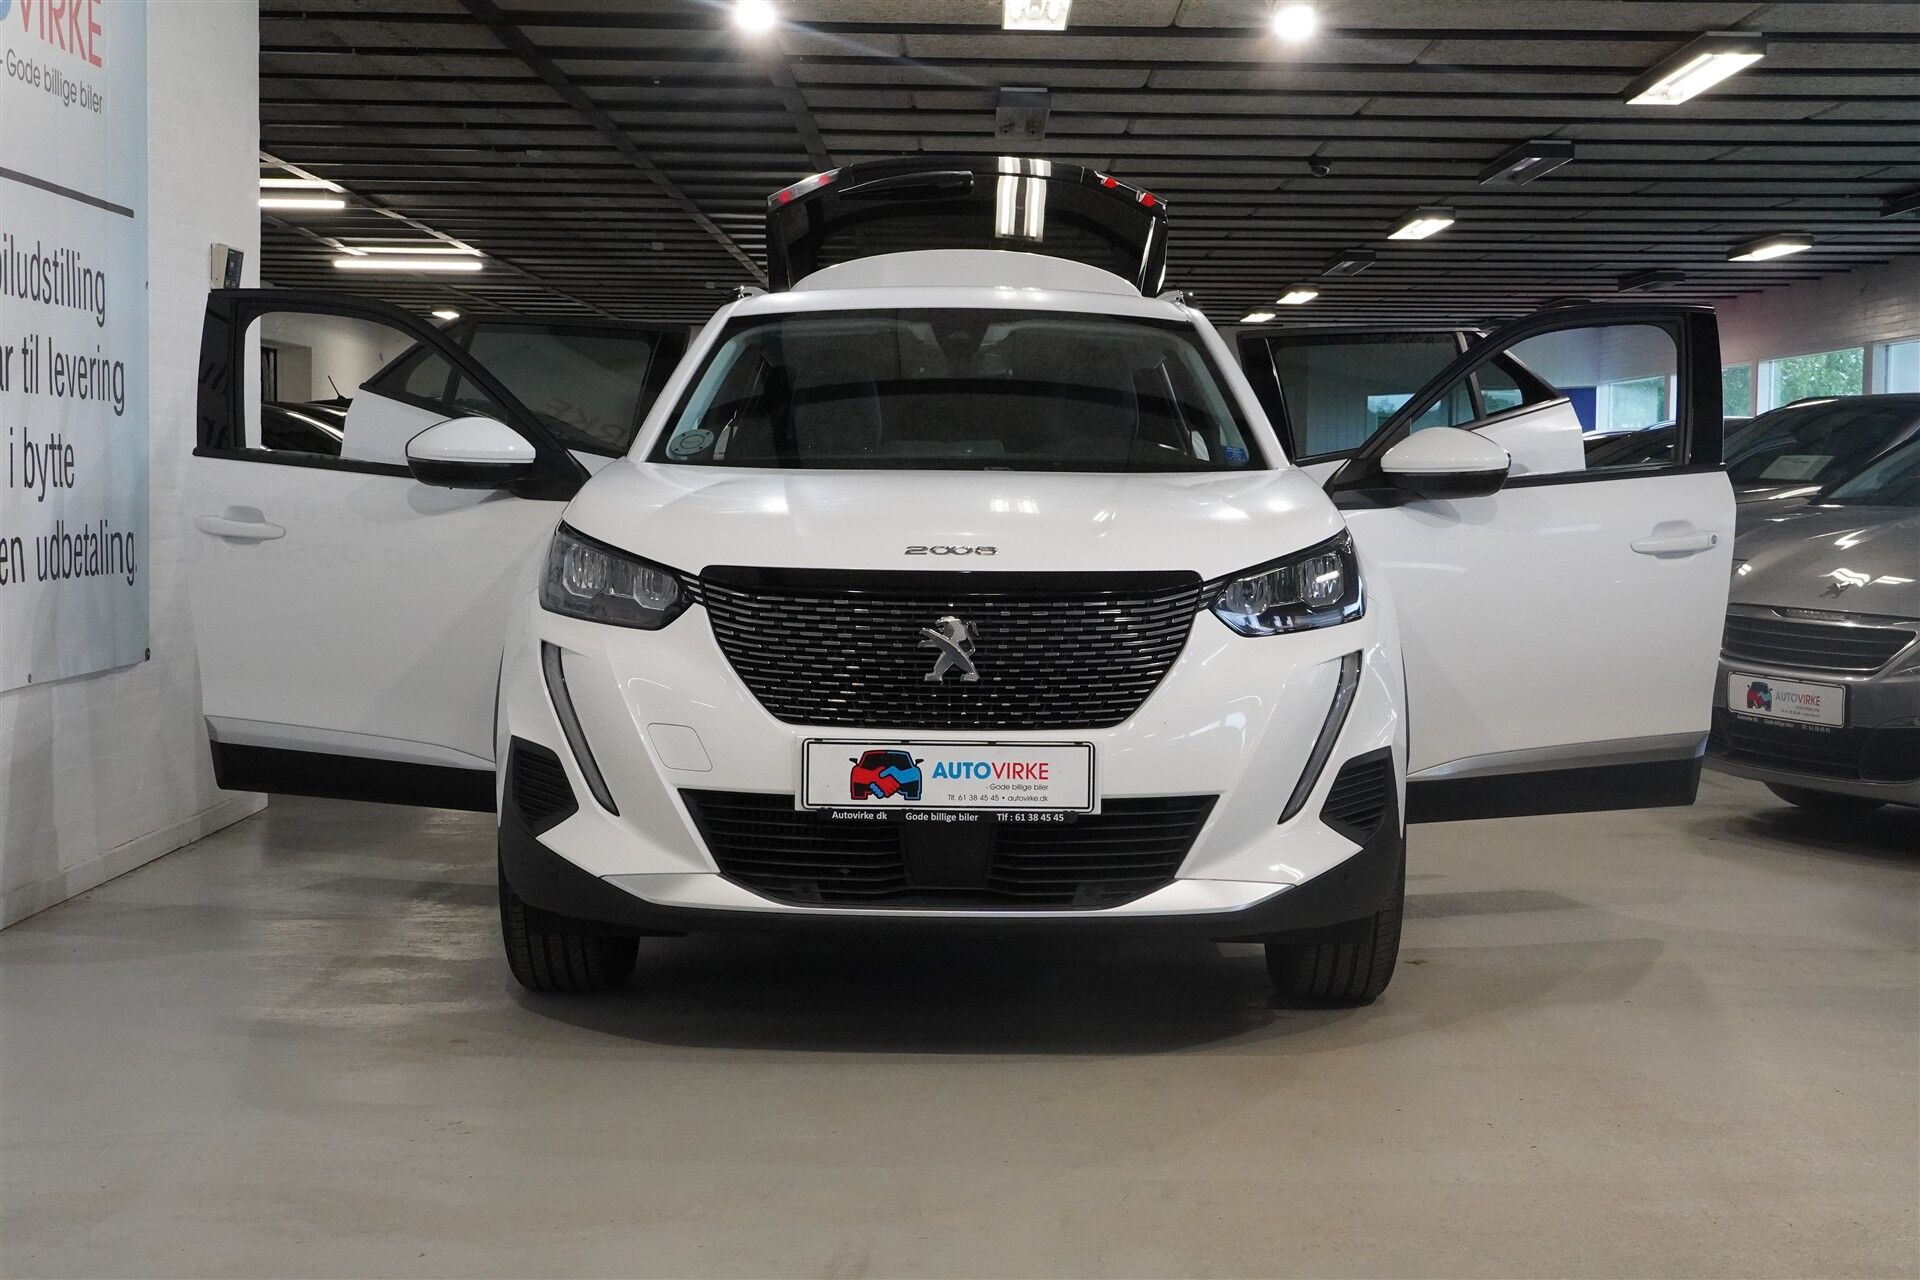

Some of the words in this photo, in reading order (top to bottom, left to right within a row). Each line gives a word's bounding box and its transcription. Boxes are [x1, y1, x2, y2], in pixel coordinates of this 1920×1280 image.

[6, 48, 41, 88] Gode
[43, 64, 77, 108] billige
[79, 81, 103, 115] biler
[0, 233, 106, 328] iludstilling
[22, 334, 39, 394] til
[48, 337, 125, 416] levering
[9, 427, 14, 488] i
[23, 427, 75, 502] bytte
[904, 545, 998, 556] 2008
[1775, 690, 1821, 706] AUTOVIRKE
[931, 761, 1049, 780] AUTOVIRKE
[989, 783, 1010, 791] Gode
[1011, 783, 1032, 792] billige
[968, 794, 978, 802] 38
[979, 794, 989, 802] 45
[831, 810, 875, 820] Autovirke
[876, 811, 888, 820] dk
[905, 812, 929, 821] Gode
[930, 812, 957, 823] billige
[958, 813, 979, 822] biler
[996, 813, 1009, 822] Tlf
[1014, 813, 1026, 822] 61
[1027, 813, 1039, 822] 38
[1040, 813, 1052, 822] 45
[1053, 813, 1064, 822] 45
